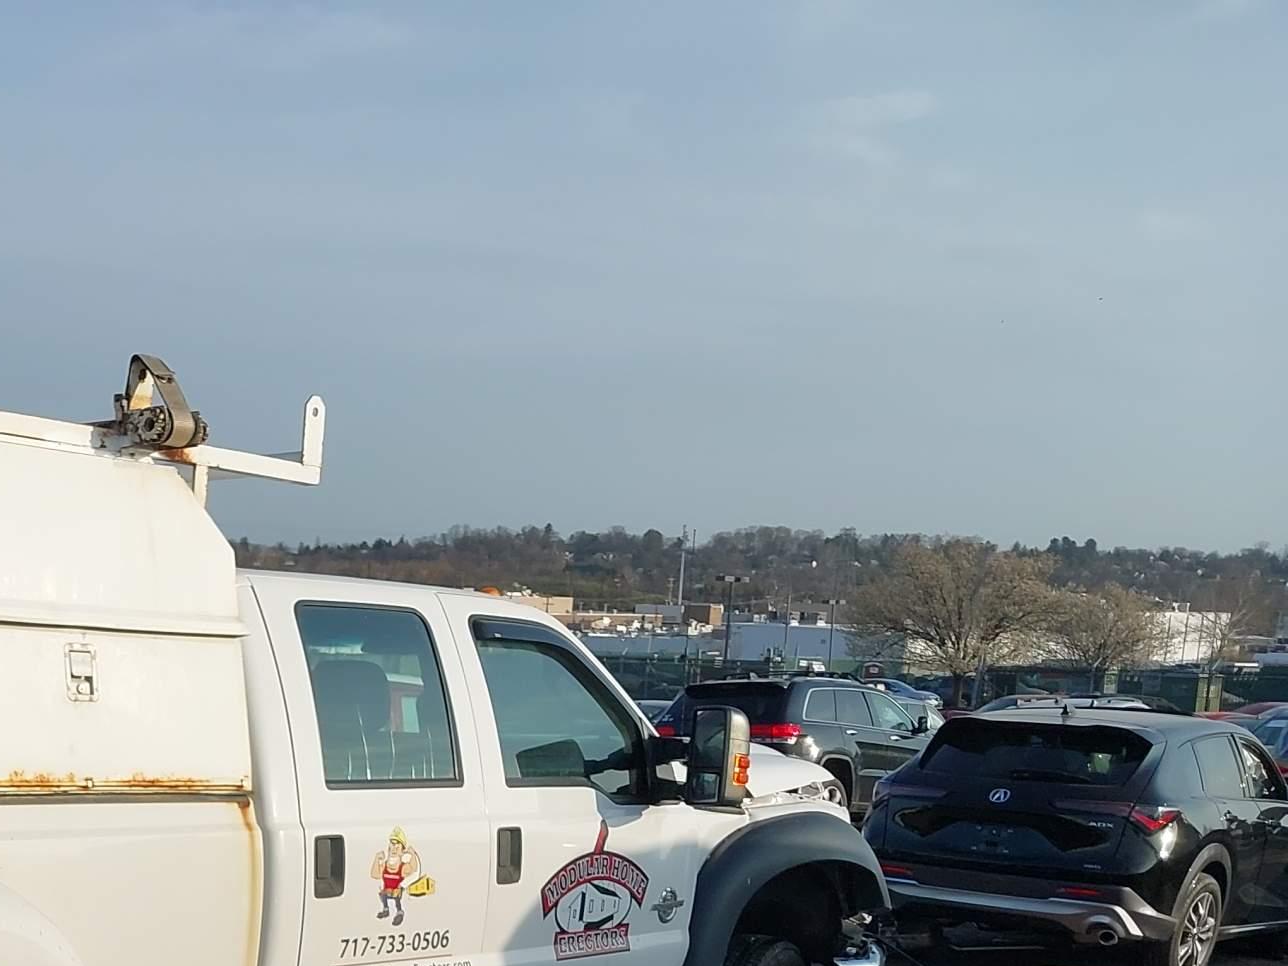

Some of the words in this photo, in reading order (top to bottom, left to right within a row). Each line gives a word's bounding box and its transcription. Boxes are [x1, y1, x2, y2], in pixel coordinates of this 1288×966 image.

[545, 854, 609, 906] MODULAR
[611, 858, 647, 898] HOME
[339, 929, 450, 959] 717-733-0506
[558, 927, 626, 956] ERECTORS
